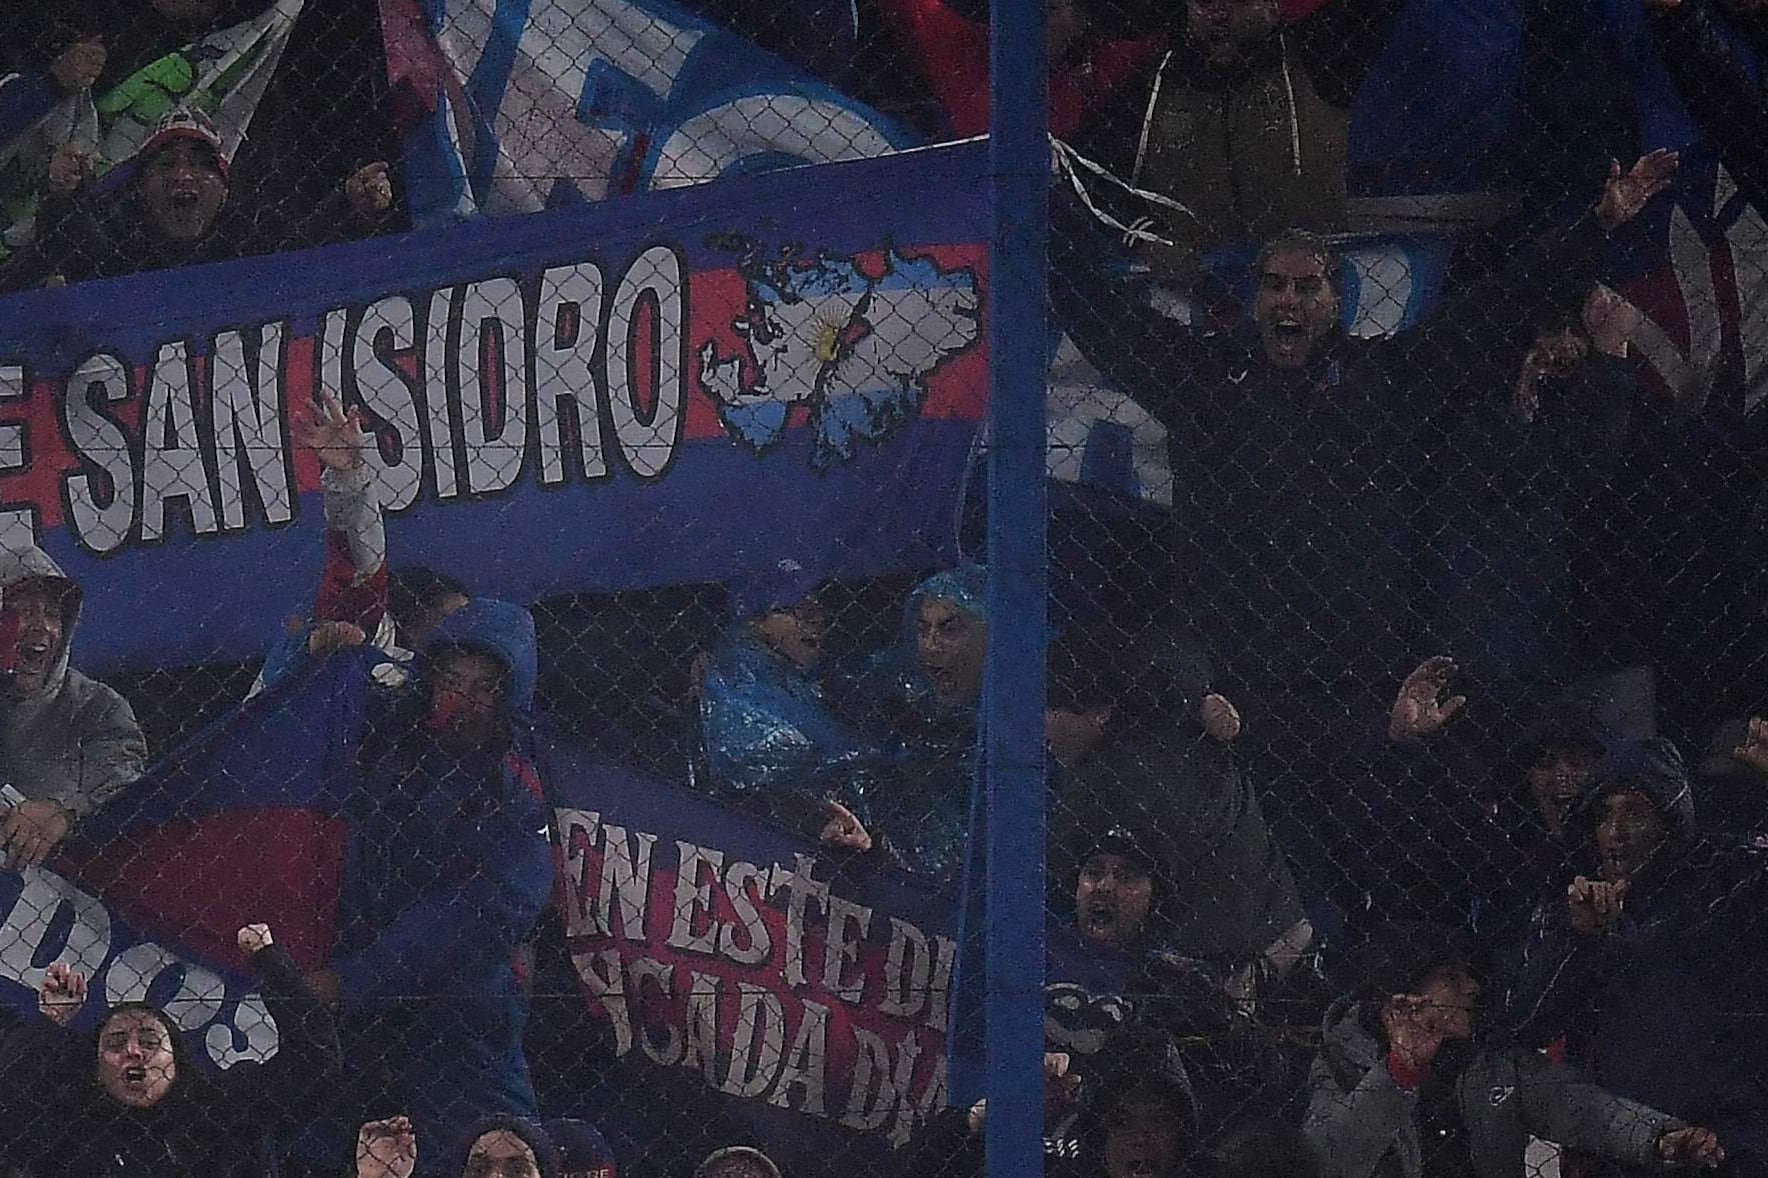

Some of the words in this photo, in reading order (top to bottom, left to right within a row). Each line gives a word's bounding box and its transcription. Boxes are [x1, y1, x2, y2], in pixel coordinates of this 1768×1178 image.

[64, 321, 293, 554] SAN
[318, 244, 682, 512] ISIDRO
[553, 807, 658, 941] EN
[664, 839, 874, 1006] ESTE
